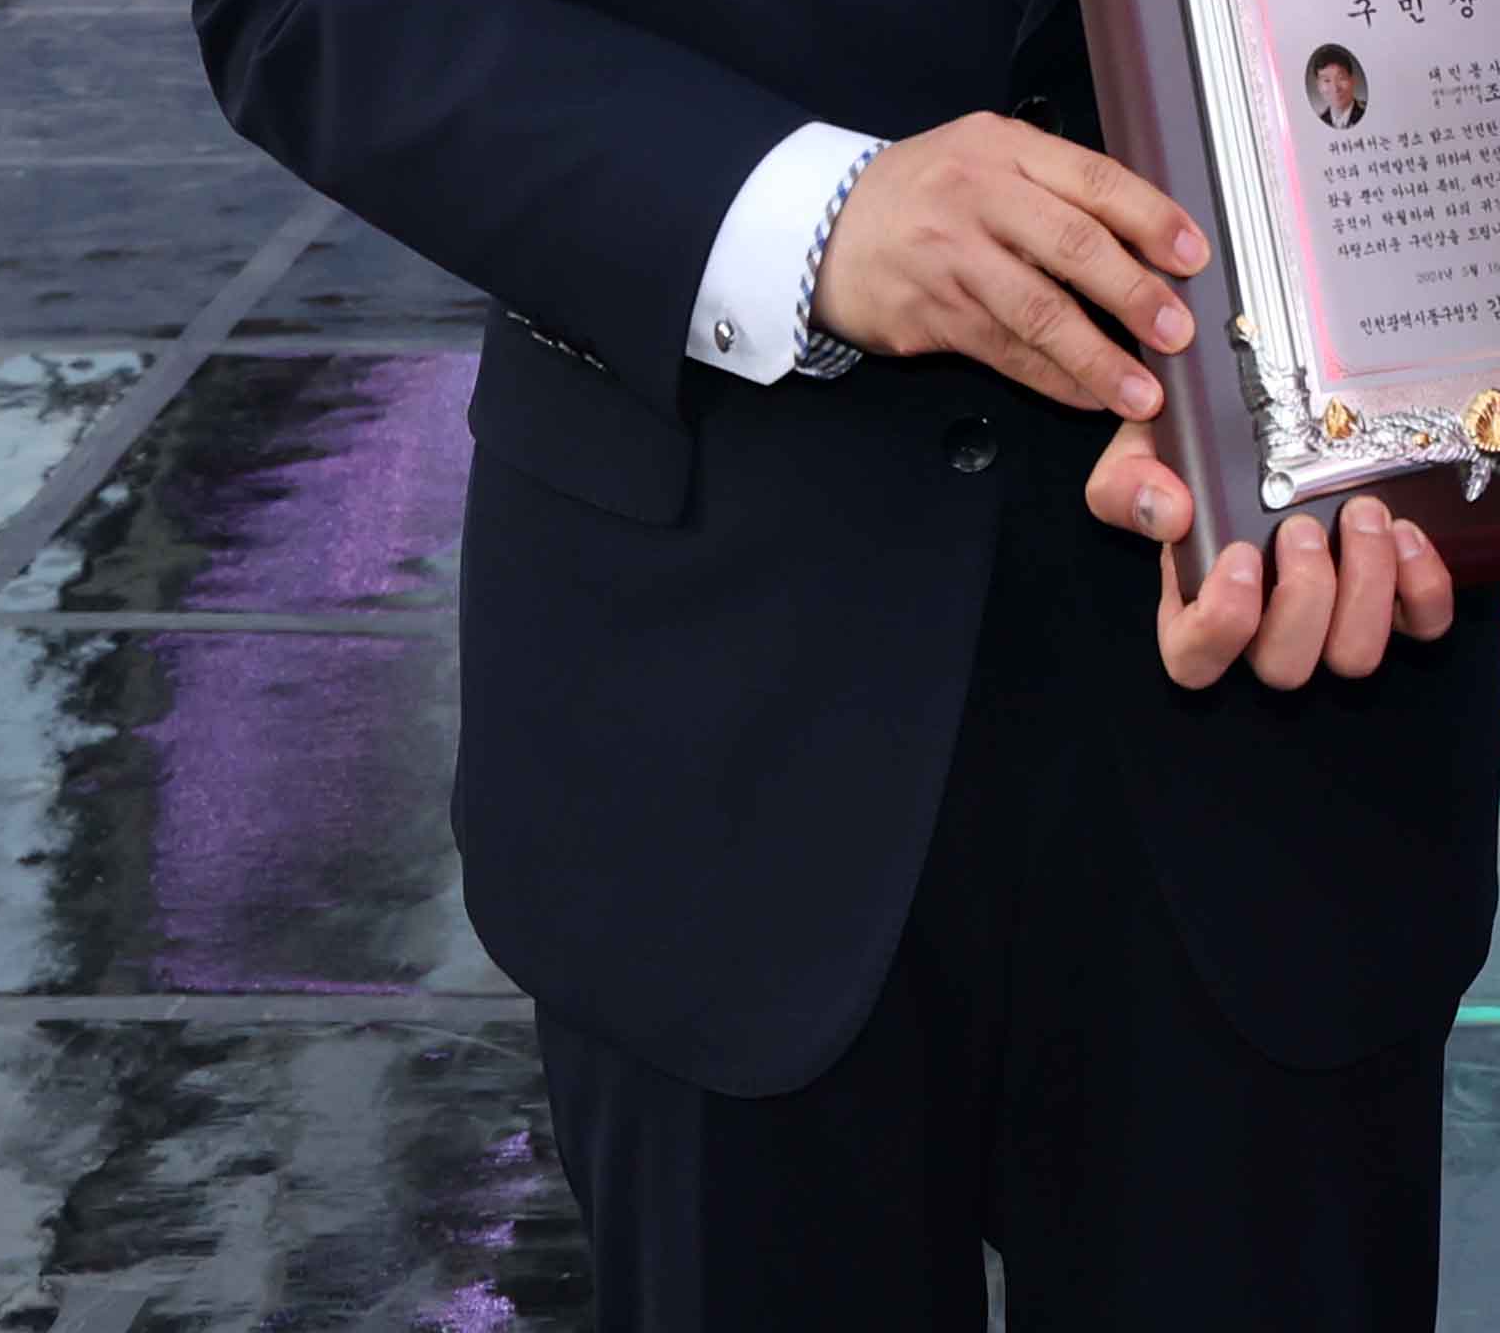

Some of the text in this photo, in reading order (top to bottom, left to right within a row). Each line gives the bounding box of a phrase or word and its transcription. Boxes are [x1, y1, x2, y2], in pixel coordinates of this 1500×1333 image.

[1393, 181, 1428, 198] 아니라
[1338, 236, 1400, 258] 자랑스러운
[1409, 231, 1459, 249] 구민상을
[1360, 303, 1478, 335] 인천광역시동구청장
